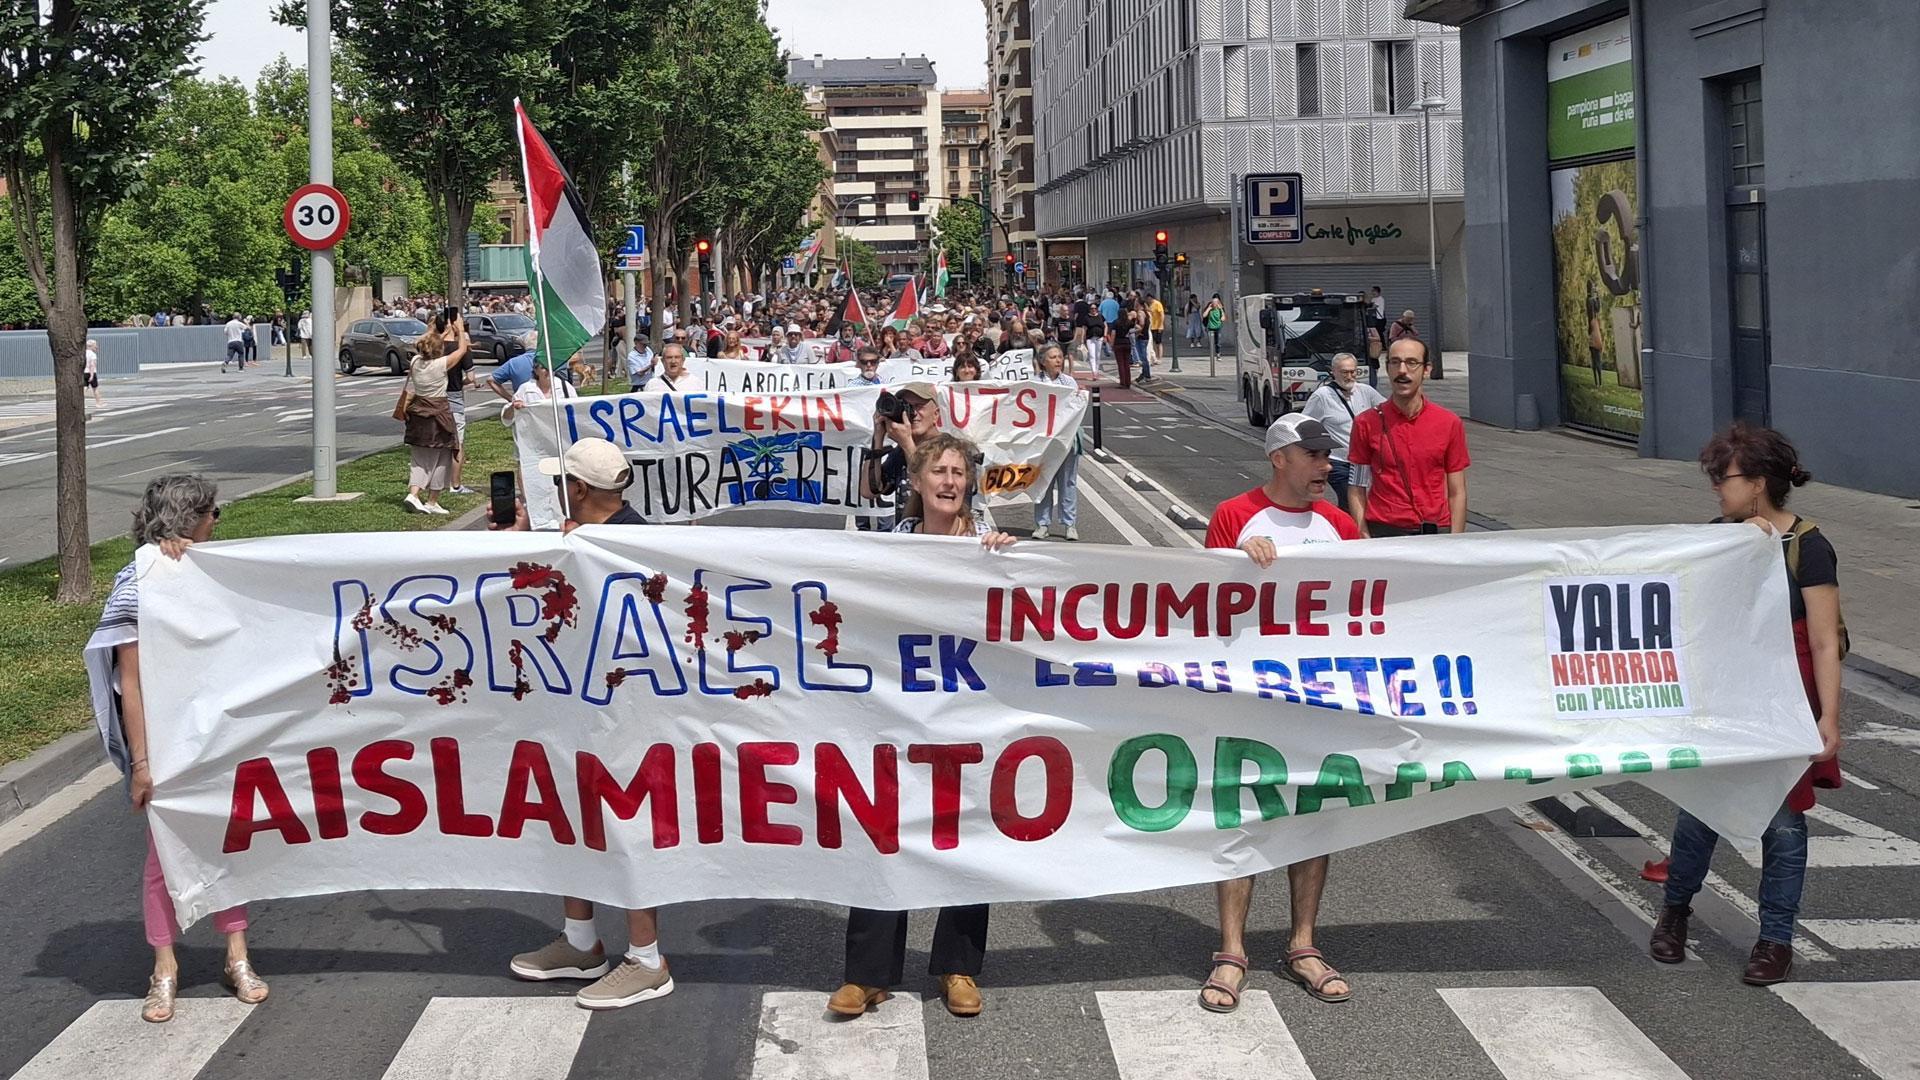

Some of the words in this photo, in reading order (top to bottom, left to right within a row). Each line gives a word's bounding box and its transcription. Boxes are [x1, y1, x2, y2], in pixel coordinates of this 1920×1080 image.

[1567, 98, 1599, 120] pamplona
[298, 205, 335, 226] 30
[1258, 181, 1290, 216] P
[1258, 231, 1292, 239] COMPLETO
[1305, 223, 1345, 240] Corte
[1346, 217, 1402, 246] Inglés
[627, 446, 747, 516] TURA
[986, 579, 1332, 642] INCUMPLE
[1549, 581, 1673, 652] YALA
[330, 562, 873, 705] ISRAEL
[899, 634, 987, 693] EK
[1551, 650, 1679, 686] NAFARROA
[1556, 692, 1588, 712] con
[1591, 684, 1684, 710] PALESTINA
[222, 734, 1074, 855] AISLAMIENTO
